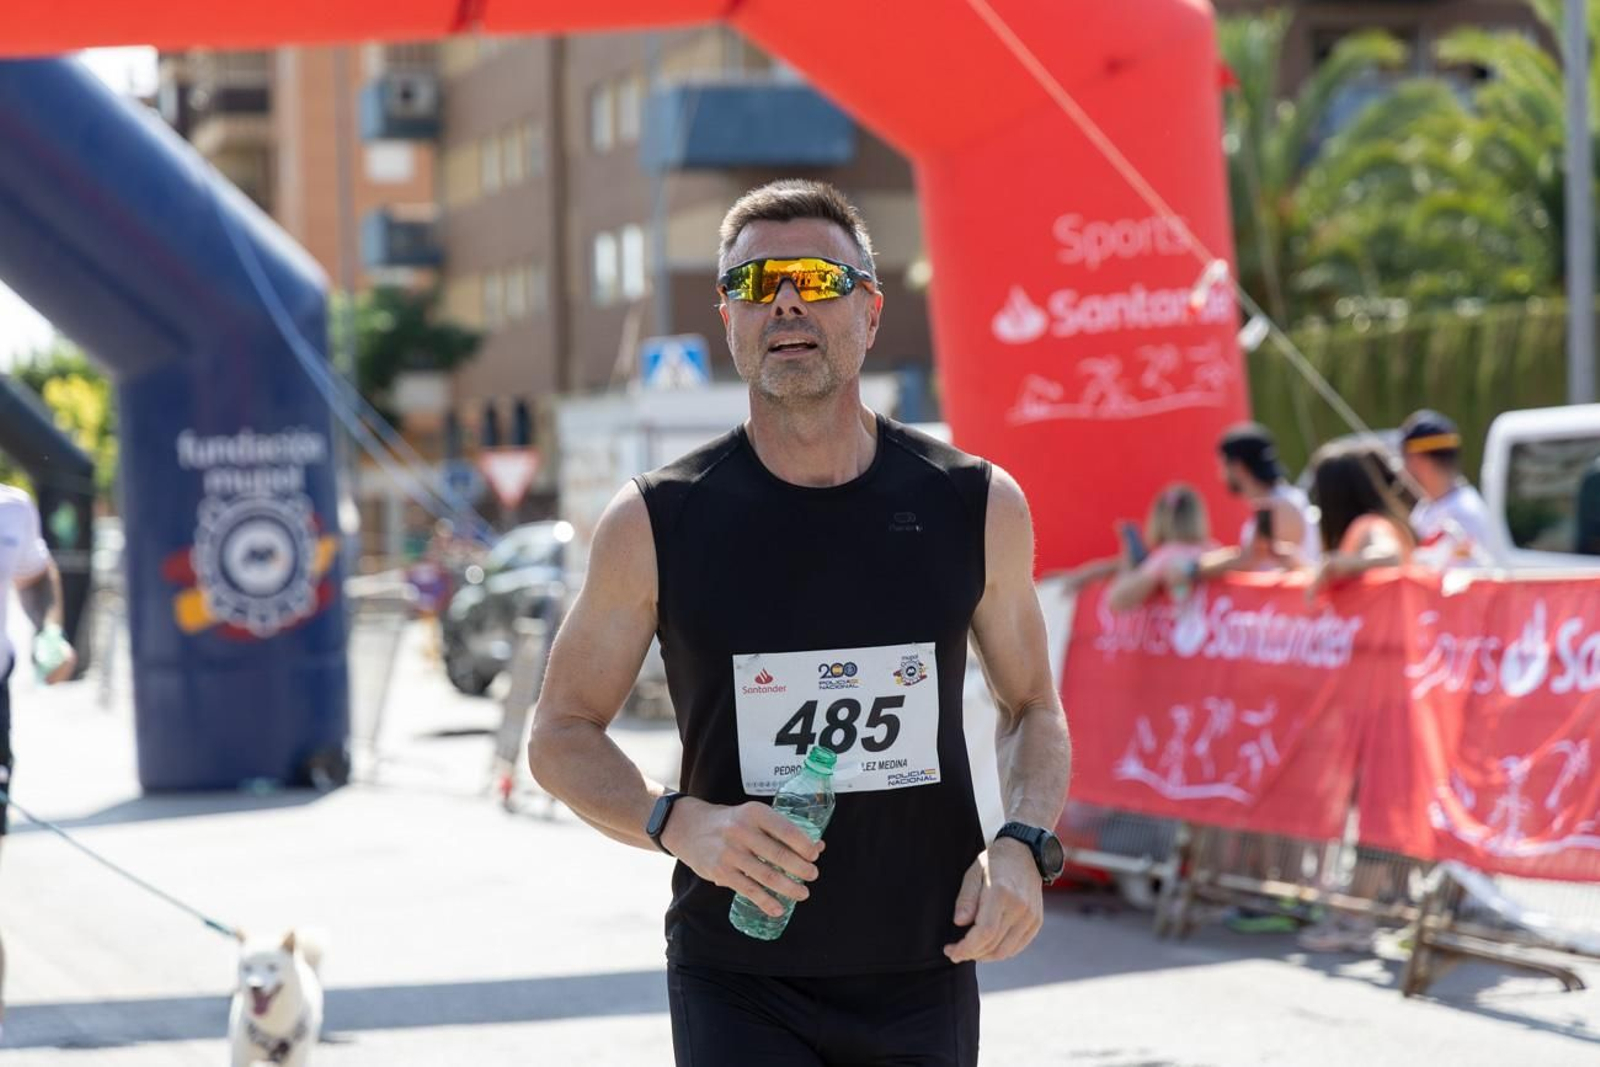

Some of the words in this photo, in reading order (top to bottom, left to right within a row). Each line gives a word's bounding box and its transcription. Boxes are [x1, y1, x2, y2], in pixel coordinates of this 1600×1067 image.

[1052, 212, 1188, 271] Sports
[1203, 595, 1364, 669] Santander
[742, 685, 787, 695] Santander
[774, 695, 906, 756] 485
[774, 764, 802, 776] PEDRO
[861, 761, 876, 772] LEZ
[878, 758, 908, 770] MEDINA
[888, 775, 937, 787] NACIONAL
